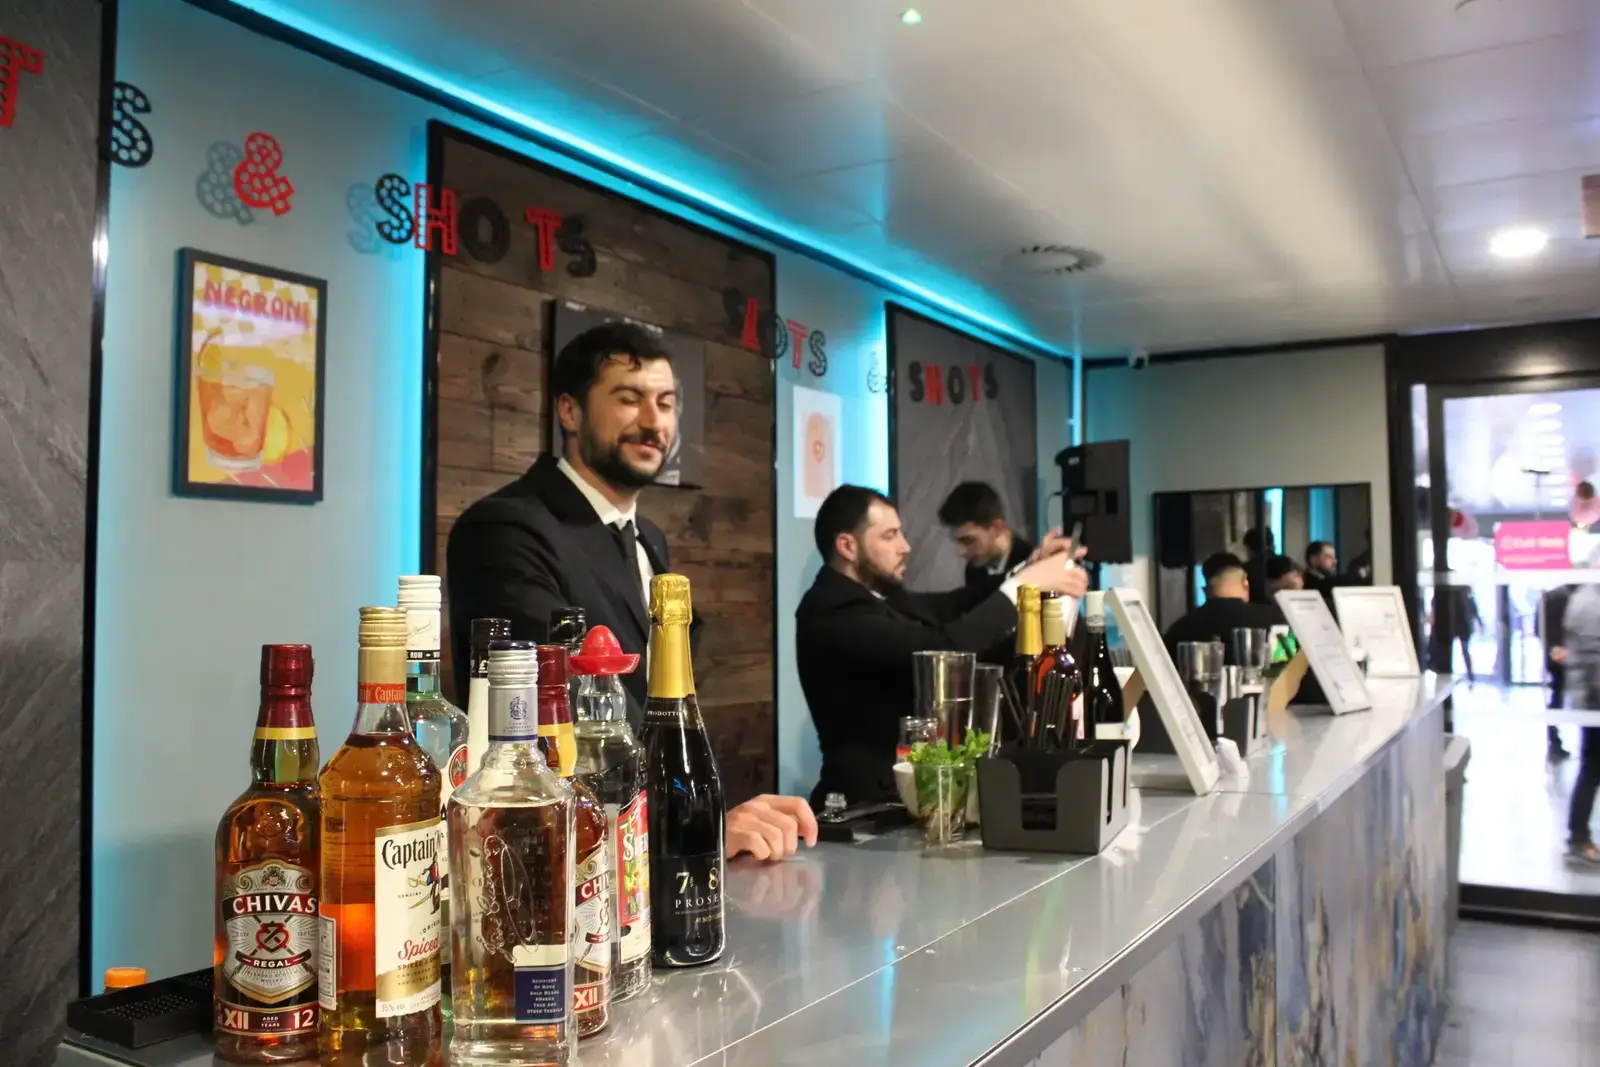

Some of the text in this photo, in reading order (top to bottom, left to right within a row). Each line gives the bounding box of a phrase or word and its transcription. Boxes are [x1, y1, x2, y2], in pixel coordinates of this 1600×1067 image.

[375, 172, 597, 277] SHOTS
[203, 279, 312, 327] NEGRONI
[908, 360, 999, 406] SHOTS
[381, 832, 435, 871] Captain
[233, 894, 316, 914] CHIVAS
[573, 988, 597, 1008] XII
[224, 1008, 249, 1030] XII
[293, 1009, 315, 1029] 12
